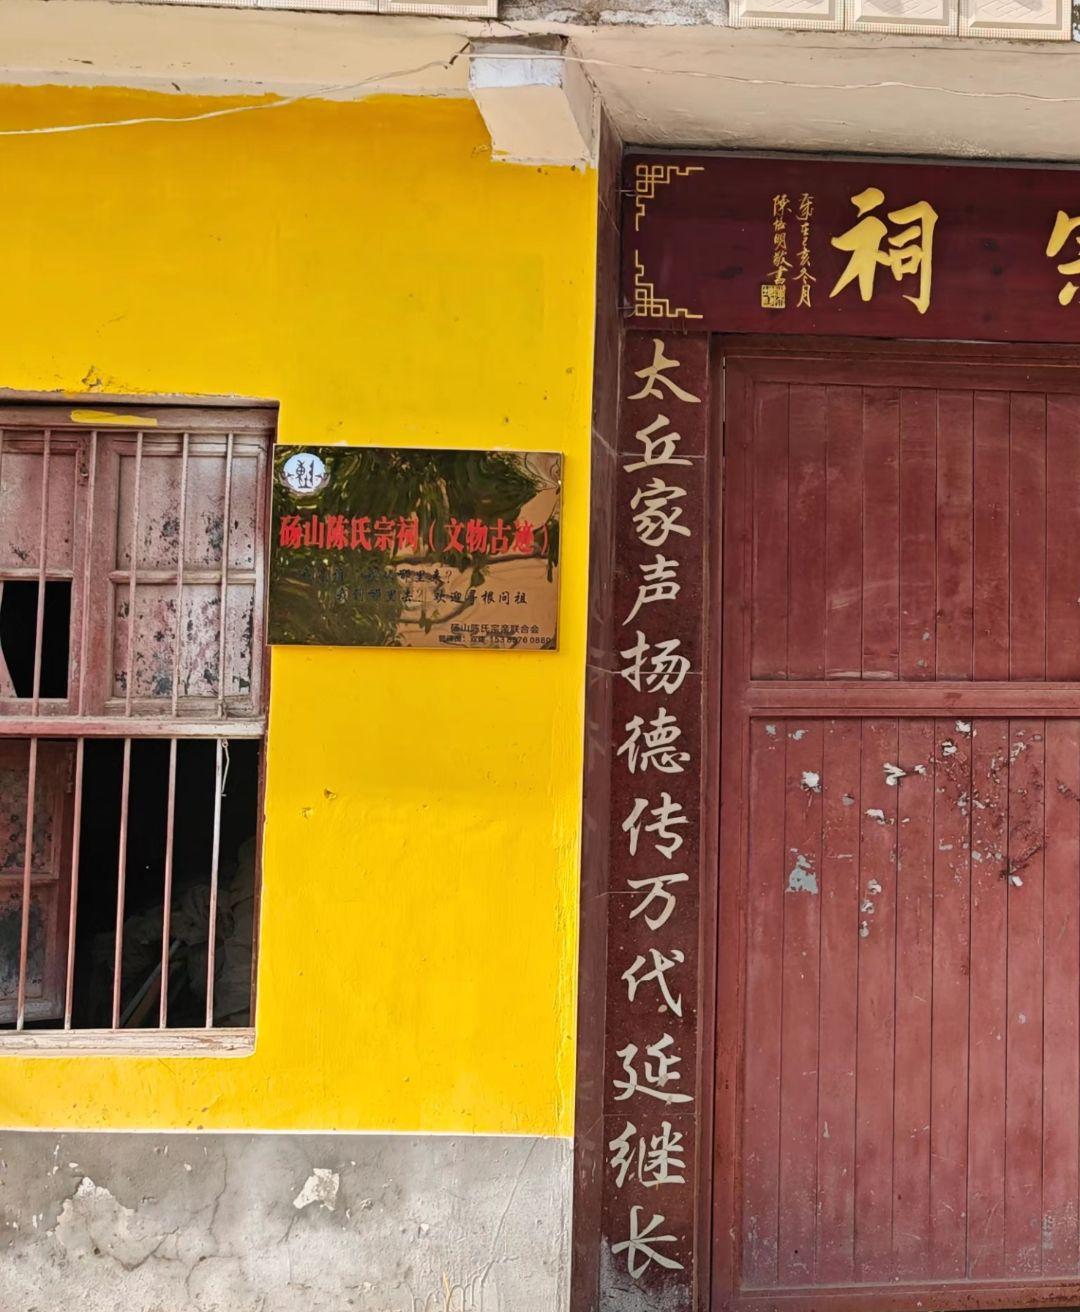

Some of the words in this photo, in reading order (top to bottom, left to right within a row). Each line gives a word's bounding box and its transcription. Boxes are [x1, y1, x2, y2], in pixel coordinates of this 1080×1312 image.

[608, 338, 702, 1280] 太丘家声扬德传万代延继长
